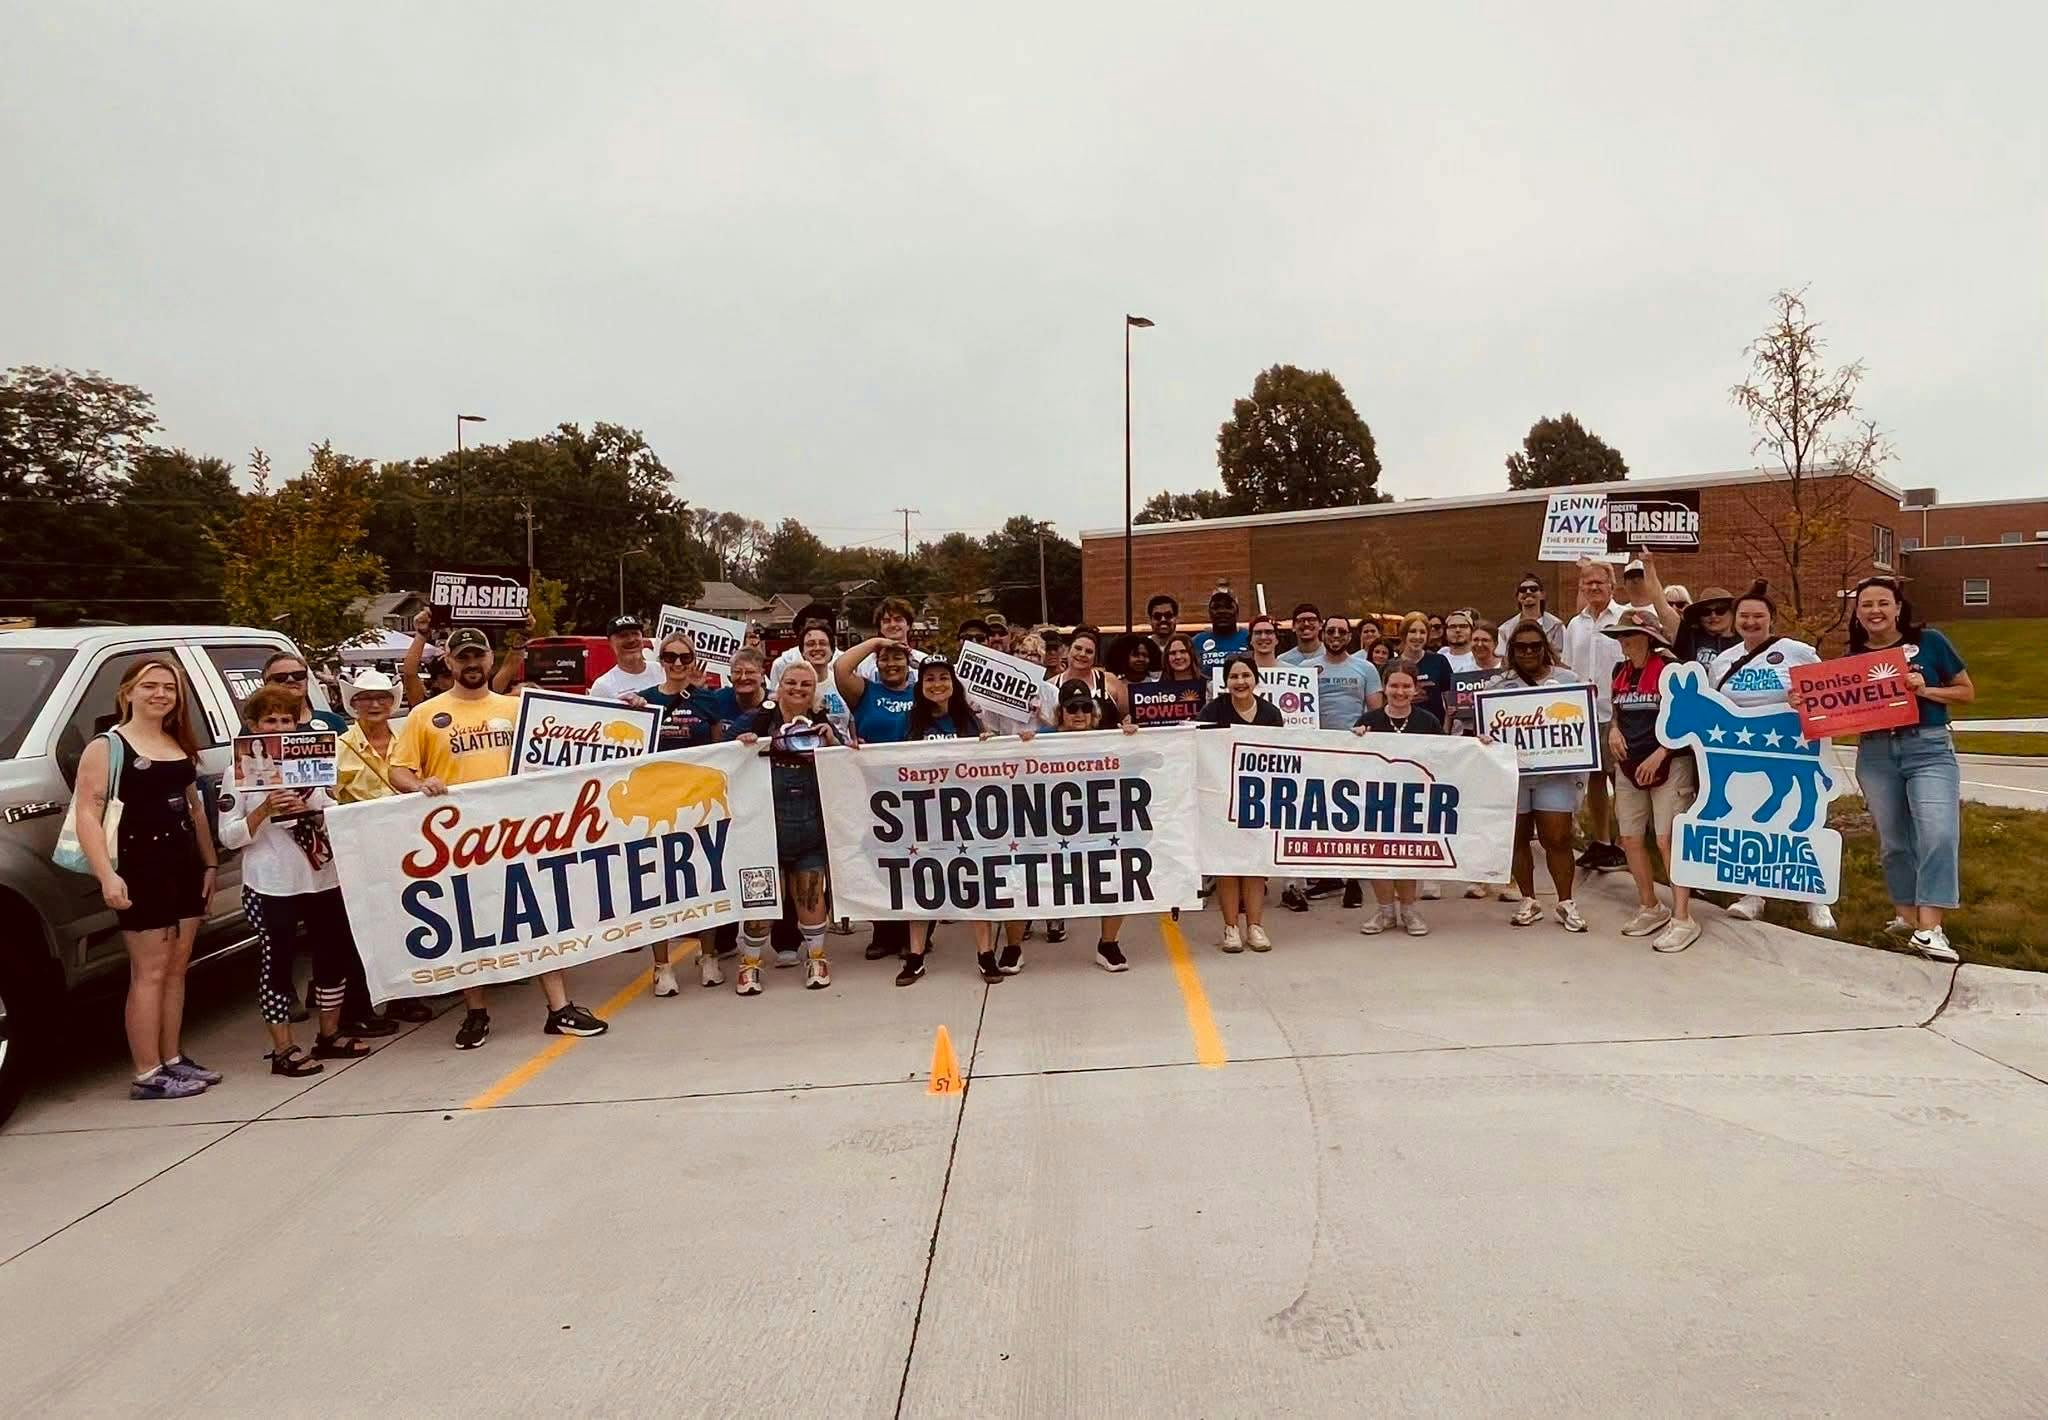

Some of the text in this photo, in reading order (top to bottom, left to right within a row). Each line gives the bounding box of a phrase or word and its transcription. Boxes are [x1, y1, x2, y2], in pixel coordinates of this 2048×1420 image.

[1610, 511, 1699, 532] BRASHER
[434, 584, 529, 607] BRASHER
[959, 661, 1038, 701] BRASHER
[1800, 673, 1863, 694] Denise
[1134, 692, 1177, 704] Denise
[1804, 681, 1905, 712] POWELL
[1135, 703, 1201, 719] POWELL
[1283, 717, 1314, 725] HOICE
[1489, 706, 1545, 729] Sarah
[450, 720, 489, 738] Sarah
[532, 715, 602, 742] Sarah
[283, 736, 316, 745] Denise
[283, 744, 336, 757] POWELL
[450, 730, 514, 754] SLATTERY
[897, 756, 1120, 789] Sarpy County Democrats
[1238, 752, 1301, 774] JOCELYN
[869, 777, 1154, 843] STRONGER
[1237, 775, 1460, 835] BRASHER
[402, 778, 608, 878] Sarah
[1288, 841, 1438, 858] FOR ATTORNEY GENERAL
[1682, 824, 1818, 866] NE YOUNG
[401, 818, 733, 960] SLATTERY
[878, 847, 1155, 911] TOGETHER
[411, 899, 732, 985] SECRETARY OF STATE
